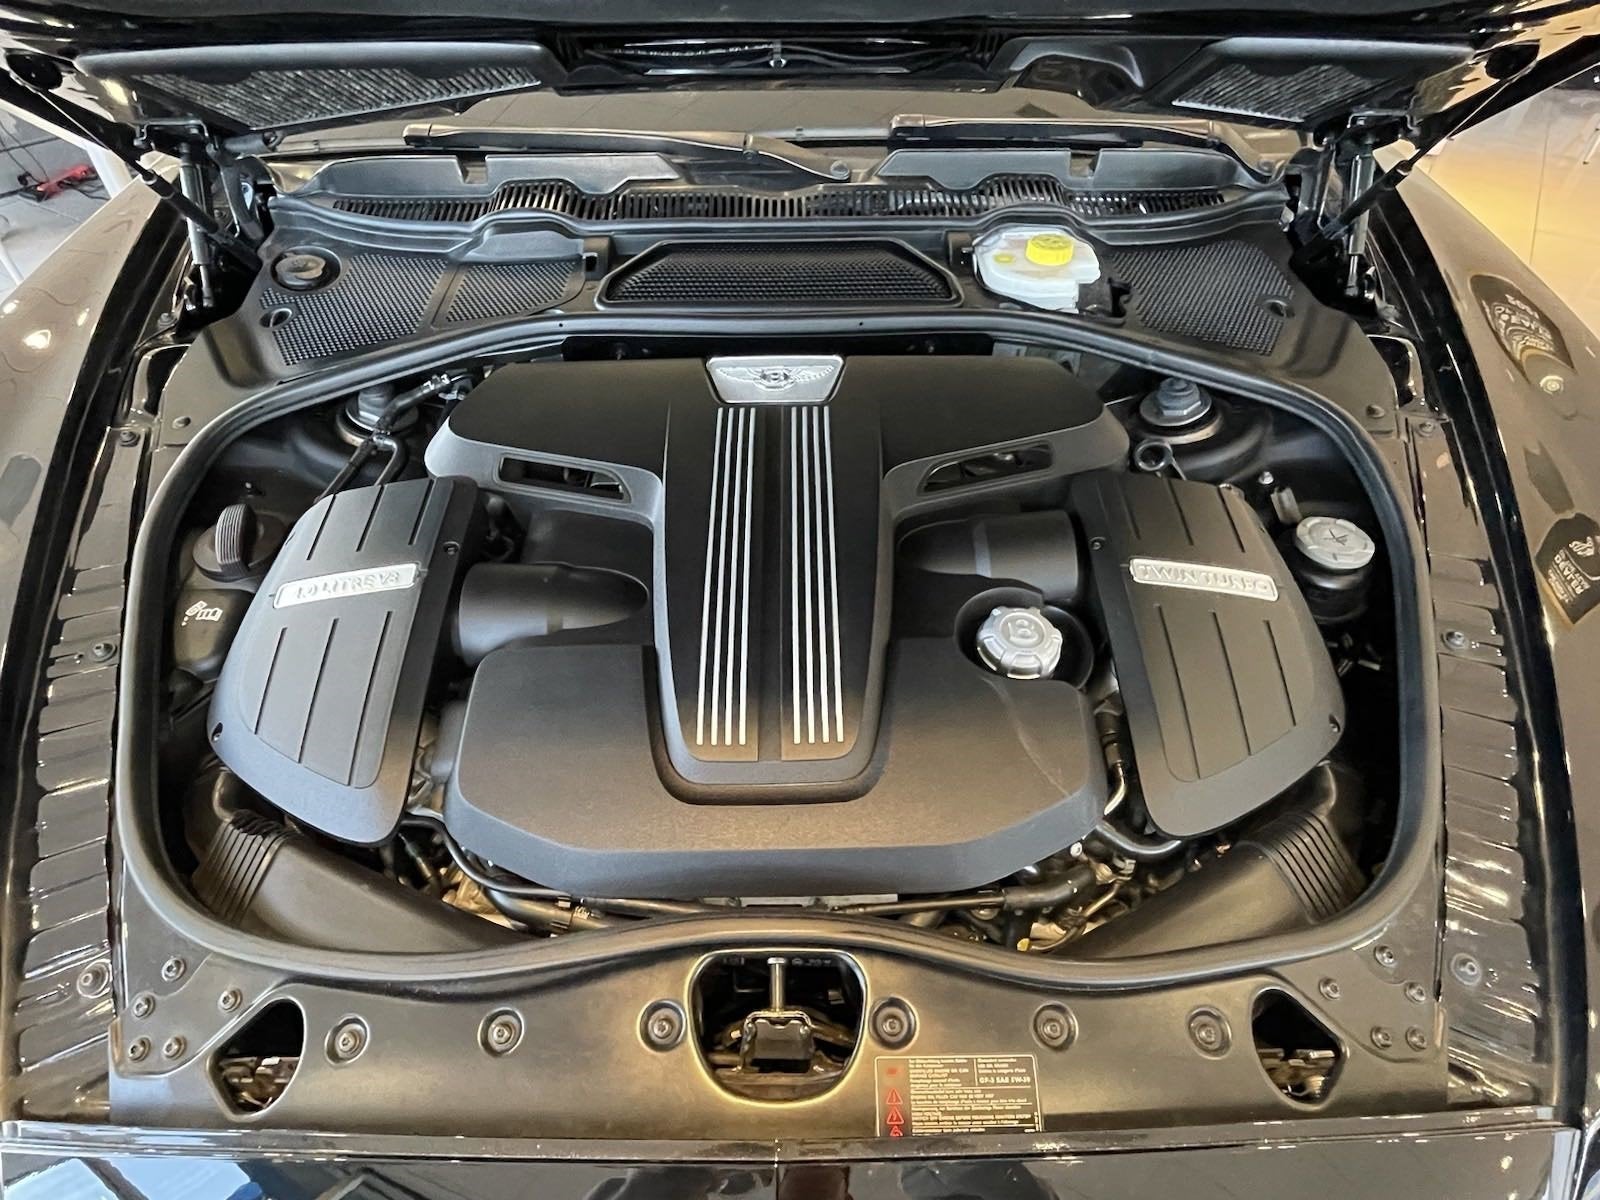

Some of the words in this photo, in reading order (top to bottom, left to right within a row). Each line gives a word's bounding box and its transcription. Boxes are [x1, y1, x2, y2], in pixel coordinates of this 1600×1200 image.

[322, 574, 377, 594] LITRE
[1136, 565, 1198, 584] TWIN
[1199, 571, 1268, 593] TURBO
